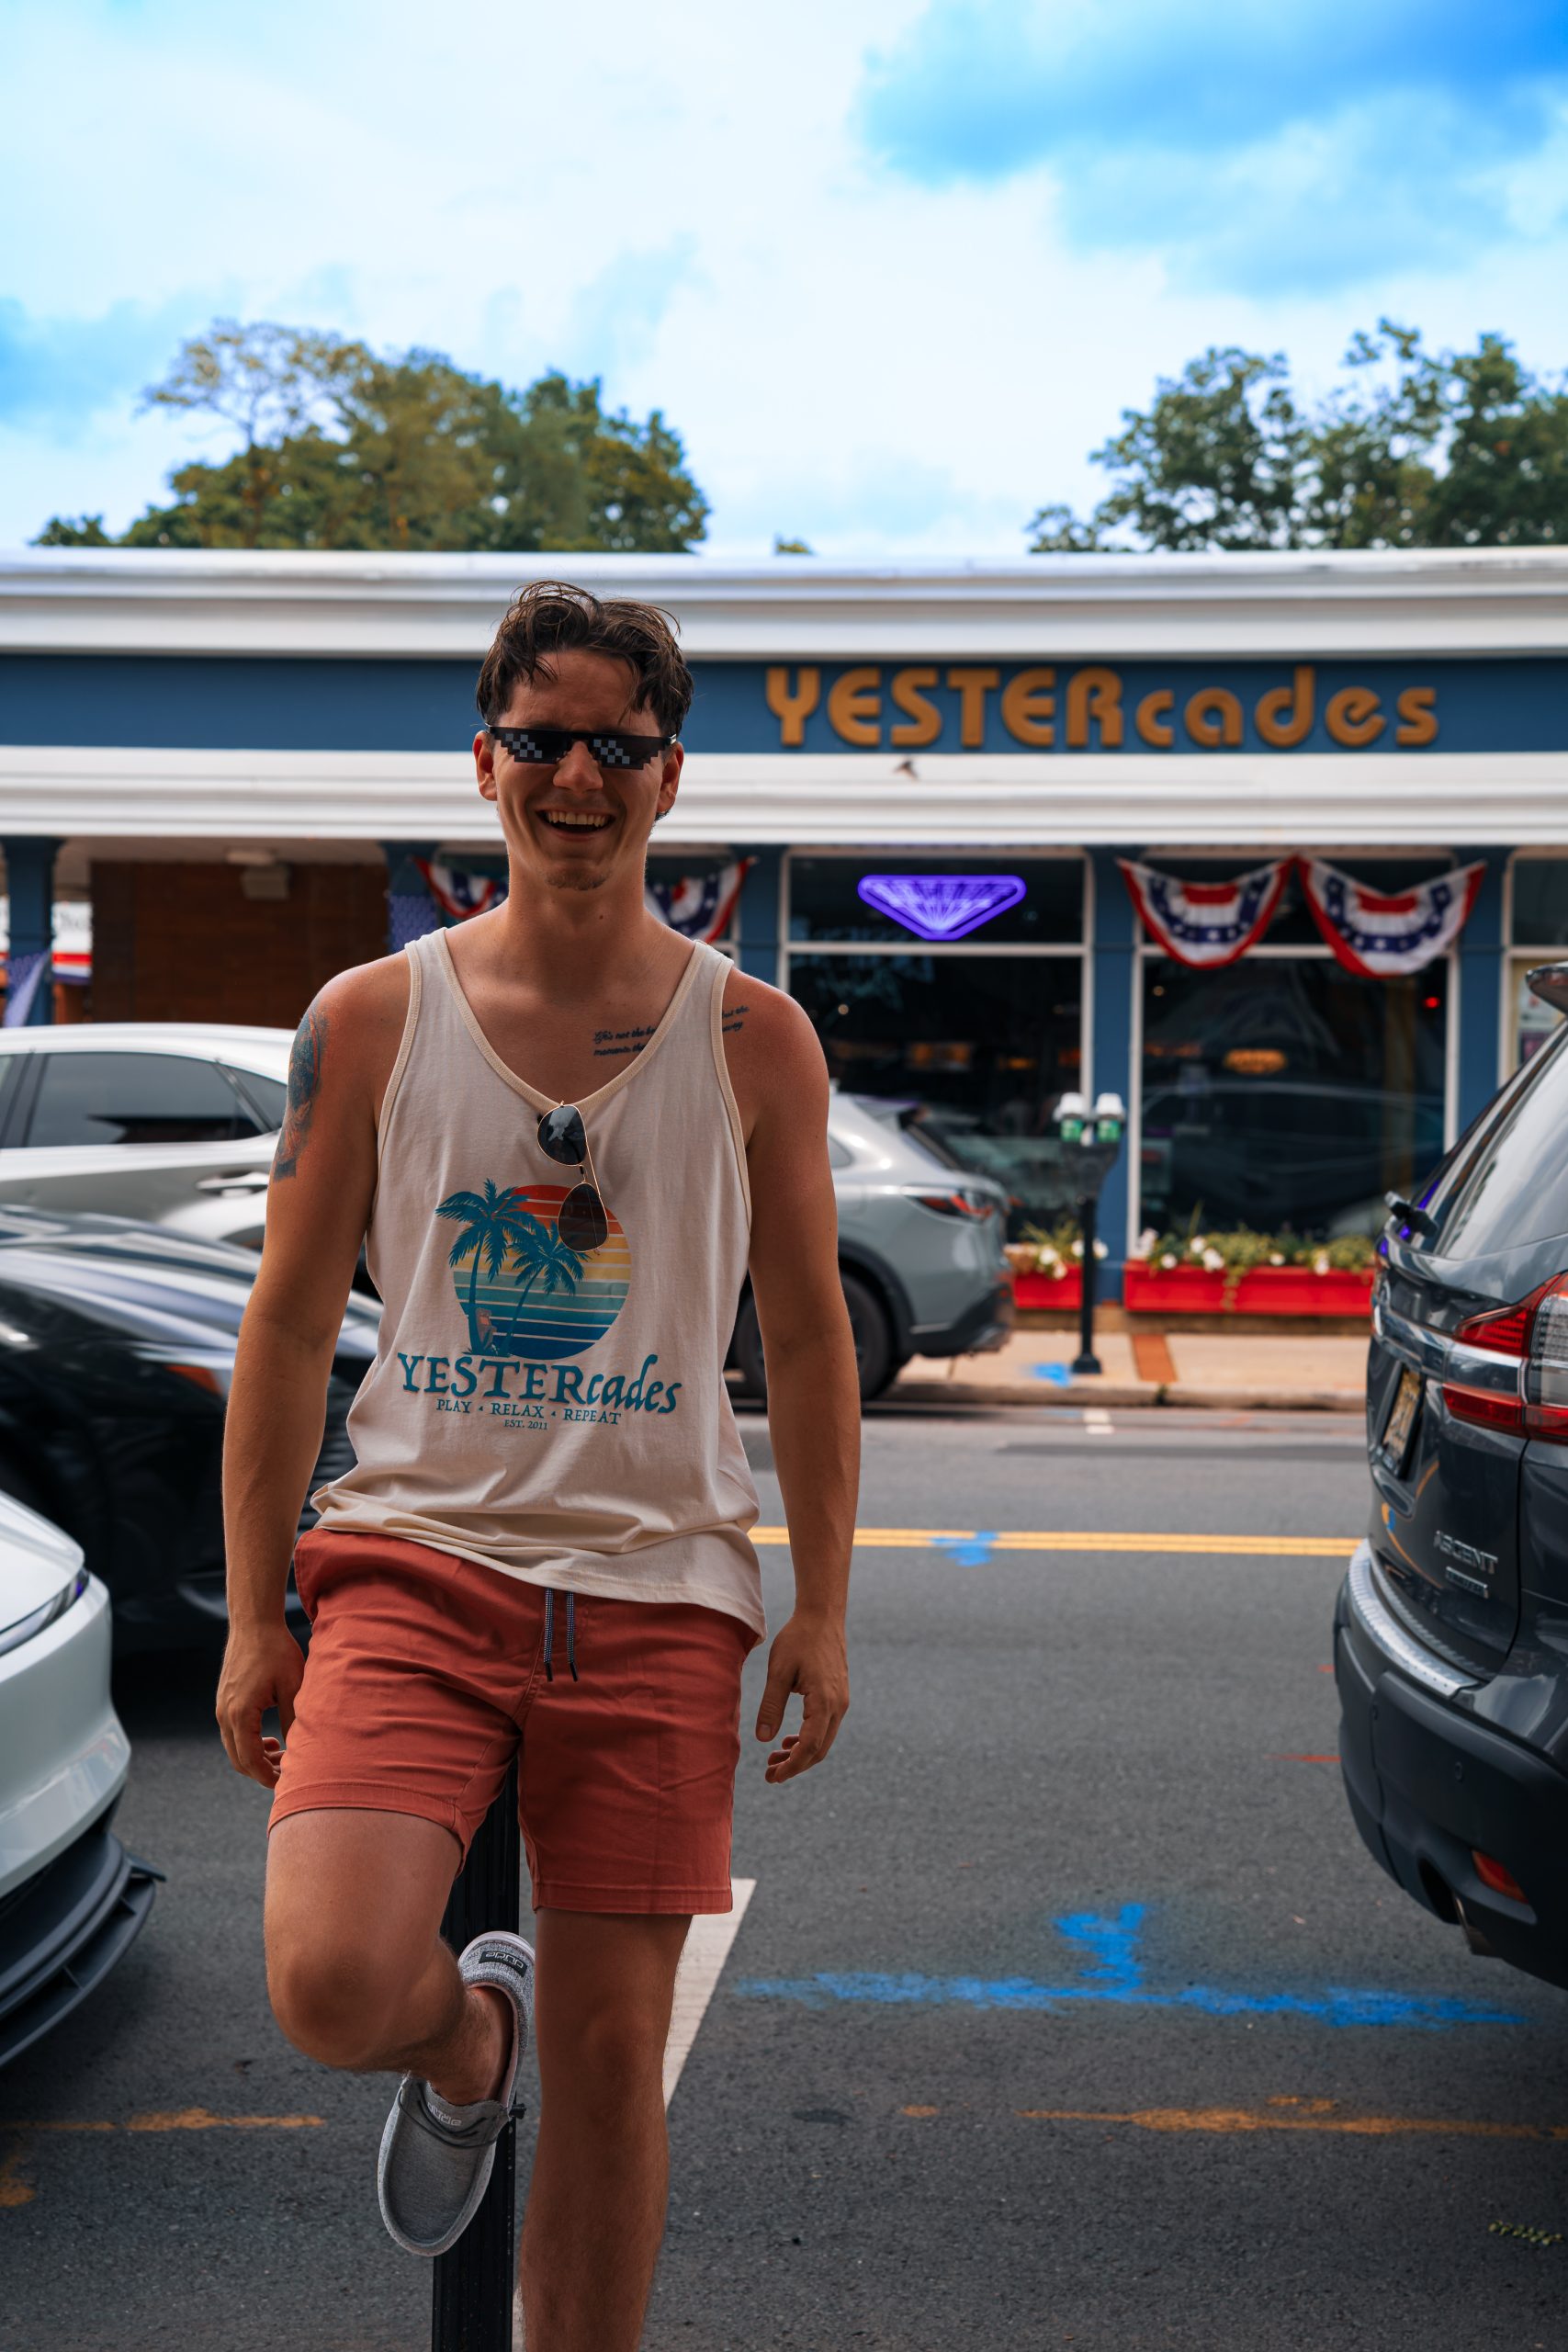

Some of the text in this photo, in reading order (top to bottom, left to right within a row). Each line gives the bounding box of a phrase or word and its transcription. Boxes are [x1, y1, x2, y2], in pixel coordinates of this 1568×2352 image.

[765, 665, 1439, 747] YESTERcades
[397, 1351, 683, 1415] YESTERcades
[436, 1398, 622, 1425] PLAY RELAX REPEAT
[504, 1419, 547, 1430] EST. 2011
